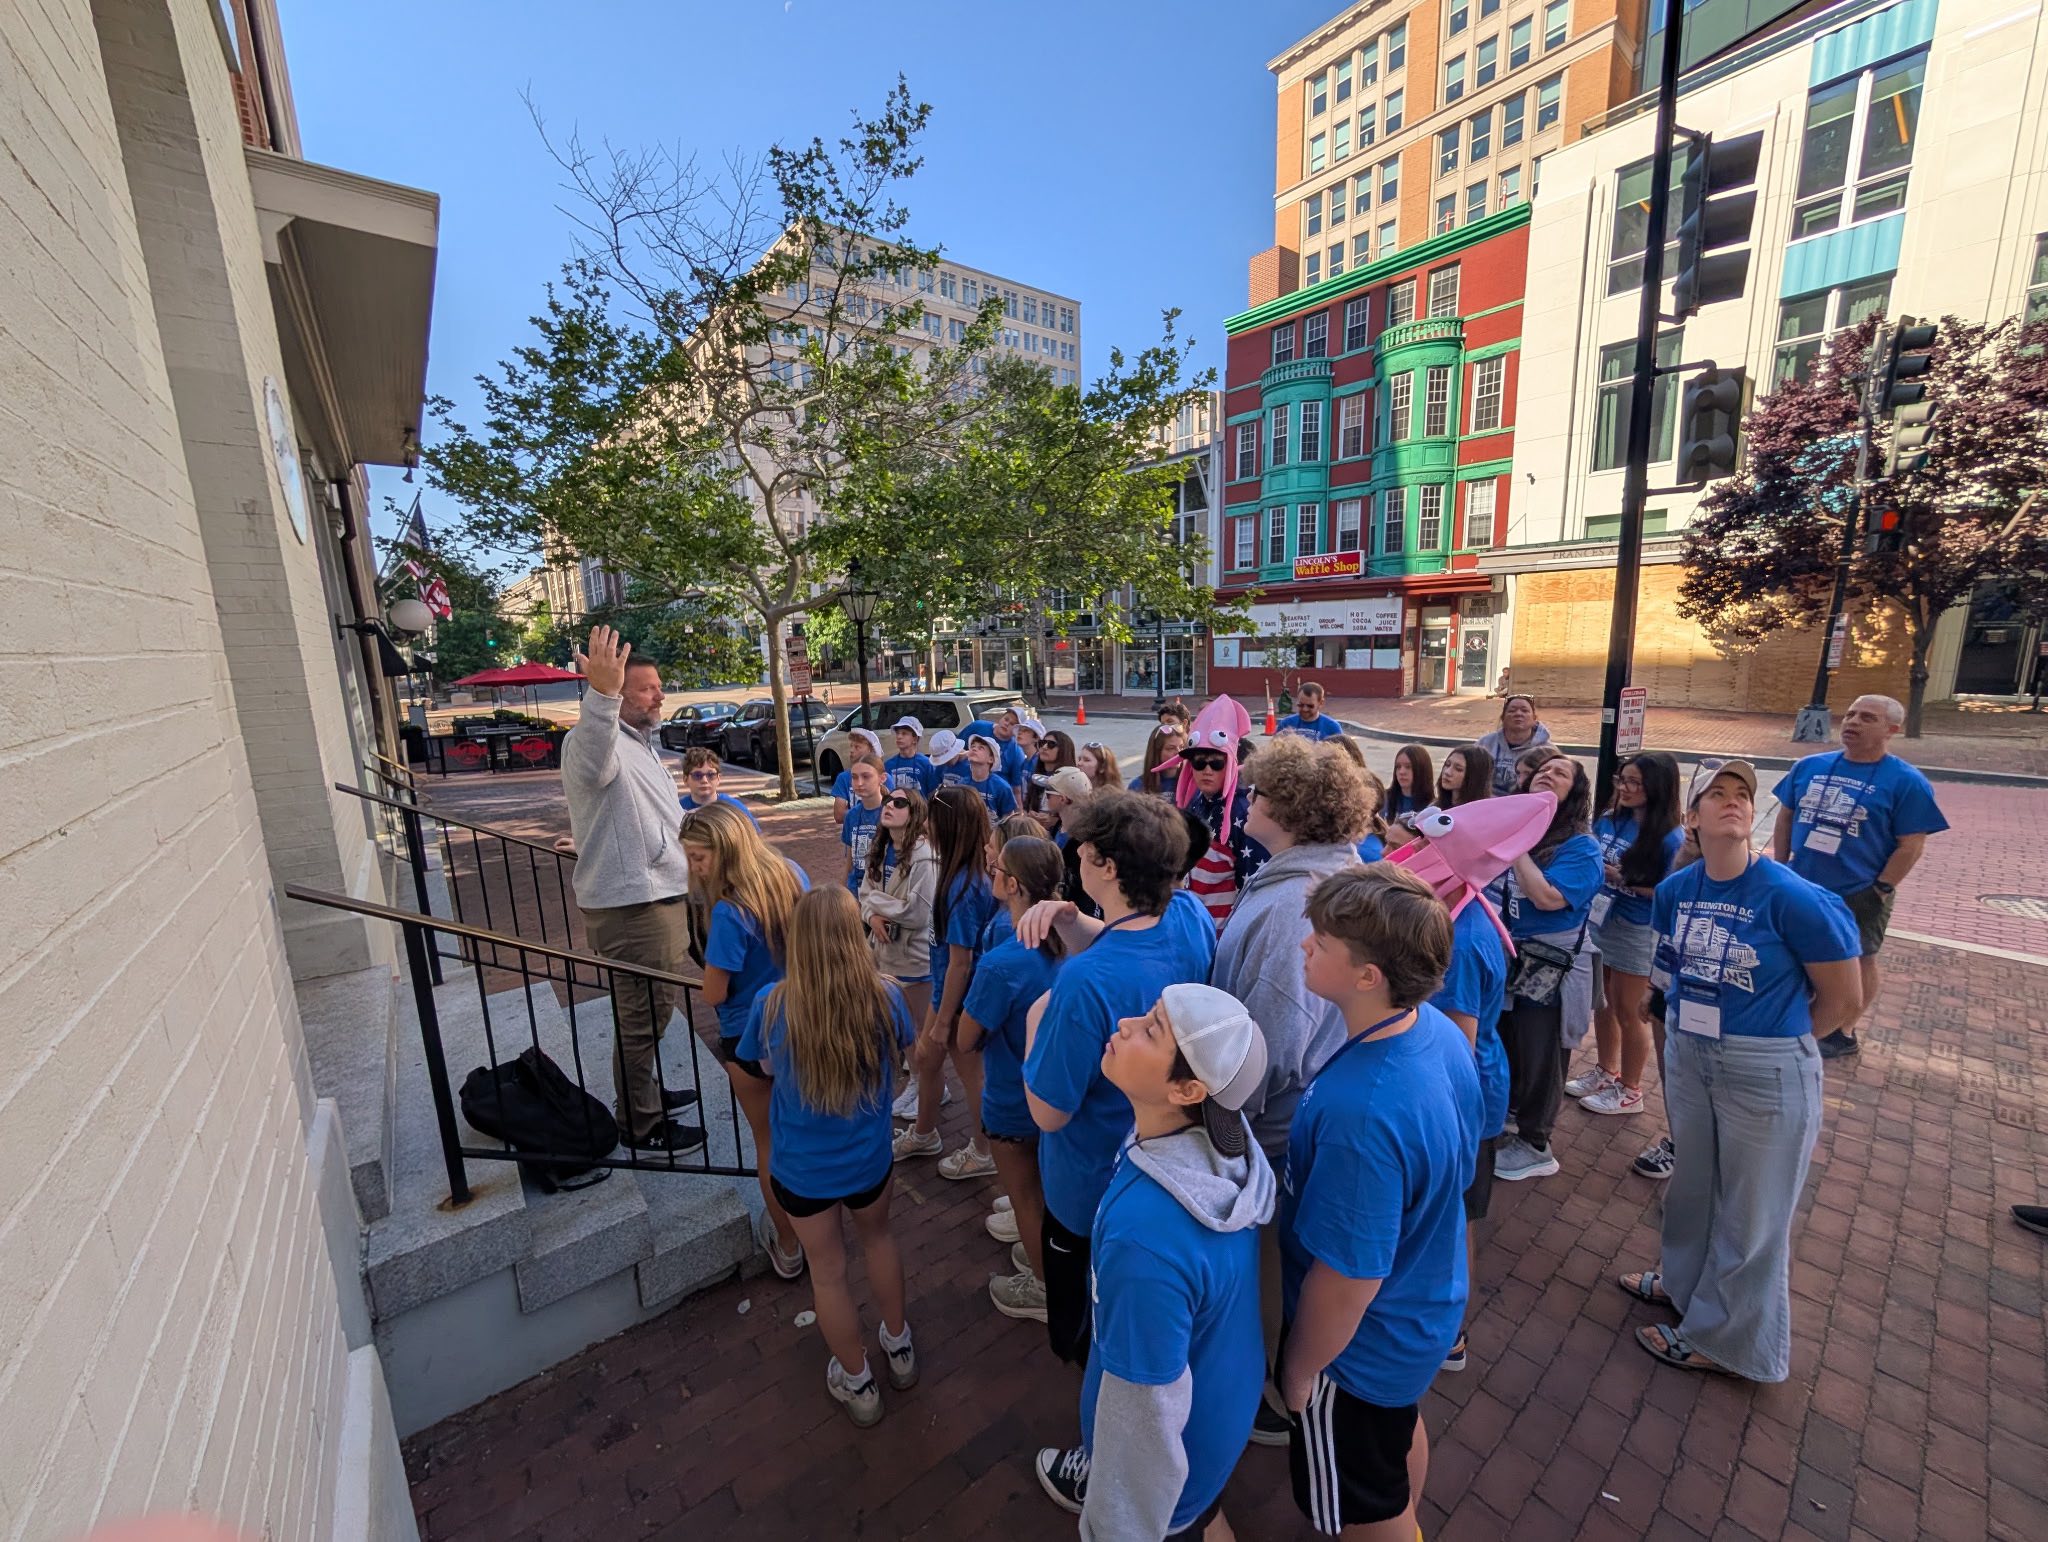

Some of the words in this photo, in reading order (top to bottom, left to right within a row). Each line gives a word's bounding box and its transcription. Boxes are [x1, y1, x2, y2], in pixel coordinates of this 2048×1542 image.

[1553, 549, 1605, 559] FRANCES
[1295, 555, 1338, 567] LINCOLN'S
[1296, 563, 1330, 575] Waffle
[1333, 560, 1360, 574] Shop
